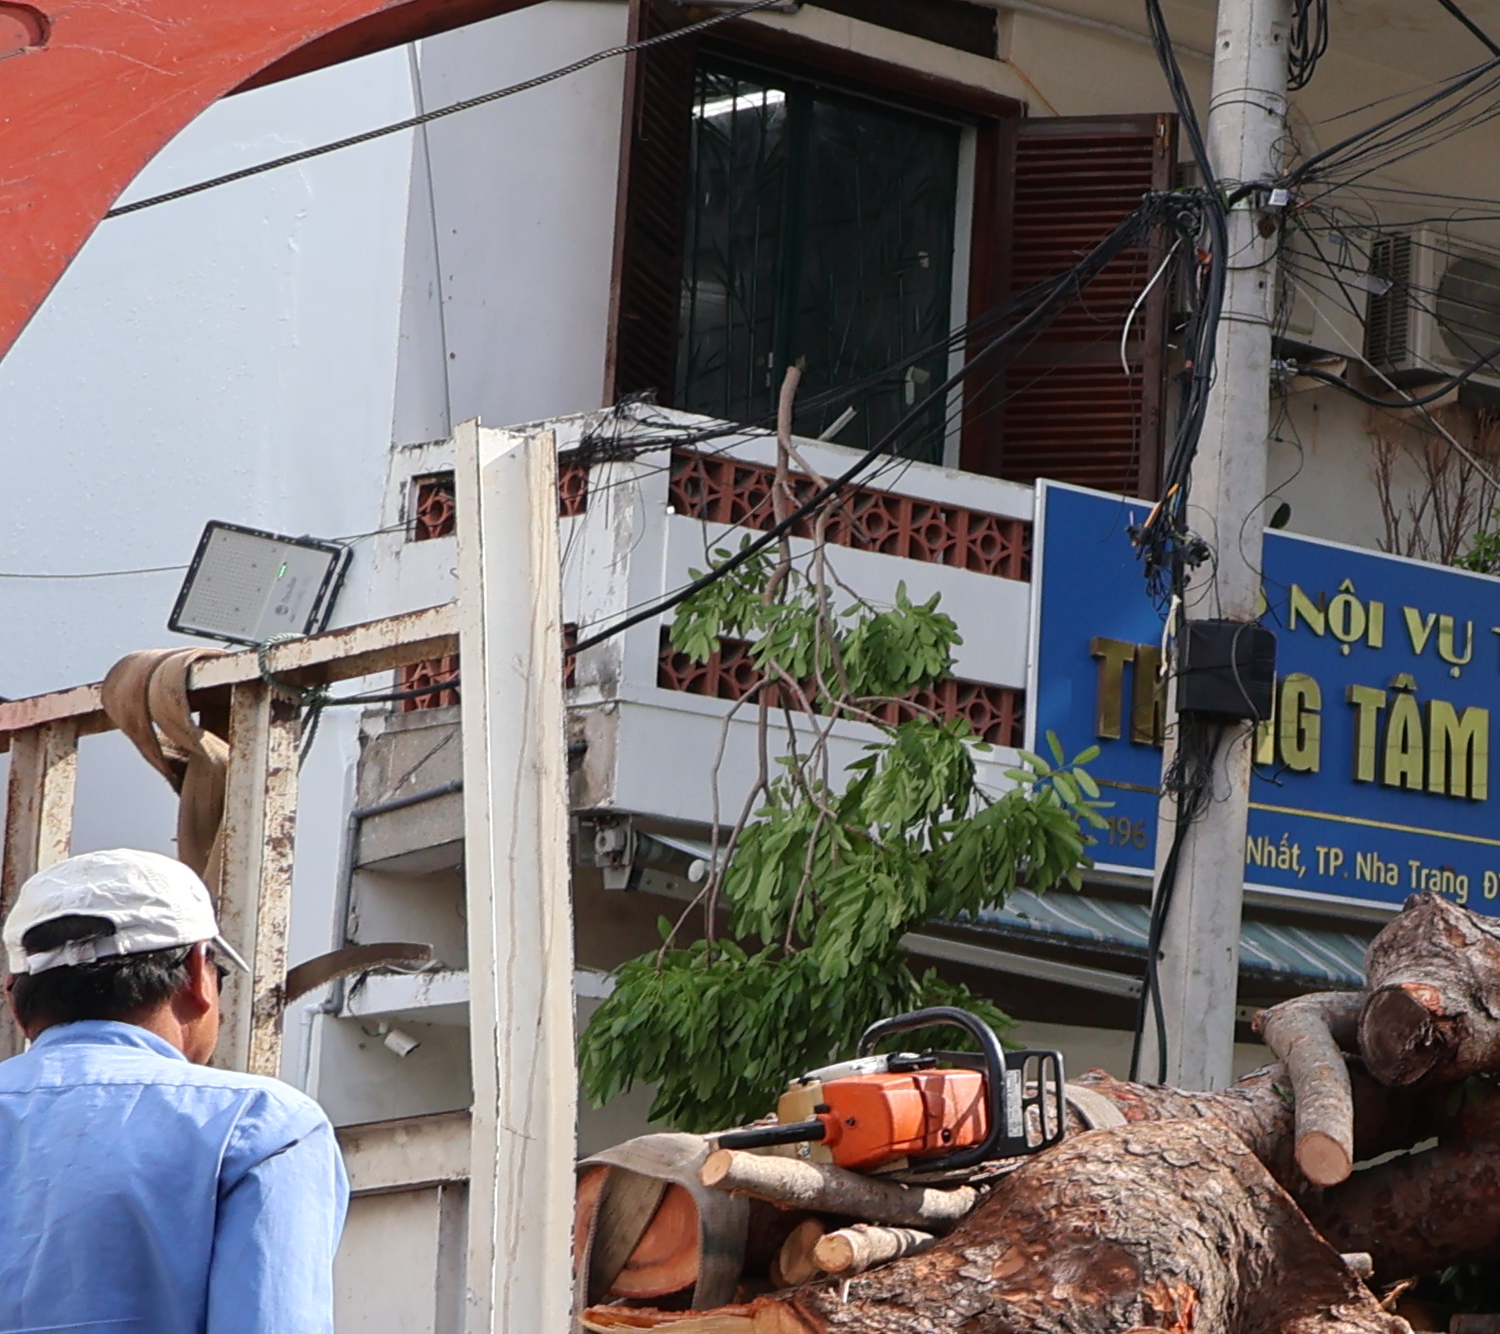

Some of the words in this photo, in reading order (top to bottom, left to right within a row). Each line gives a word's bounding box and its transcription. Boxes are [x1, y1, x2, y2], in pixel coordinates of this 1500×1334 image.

[1289, 578, 1384, 655] NỘI
[1403, 606, 1473, 678] VỤ
[1346, 672, 1489, 801] TÂM
[1245, 834, 1306, 879] Nhất,
[1355, 851, 1399, 887] Nha
[1408, 859, 1469, 905] Trang
